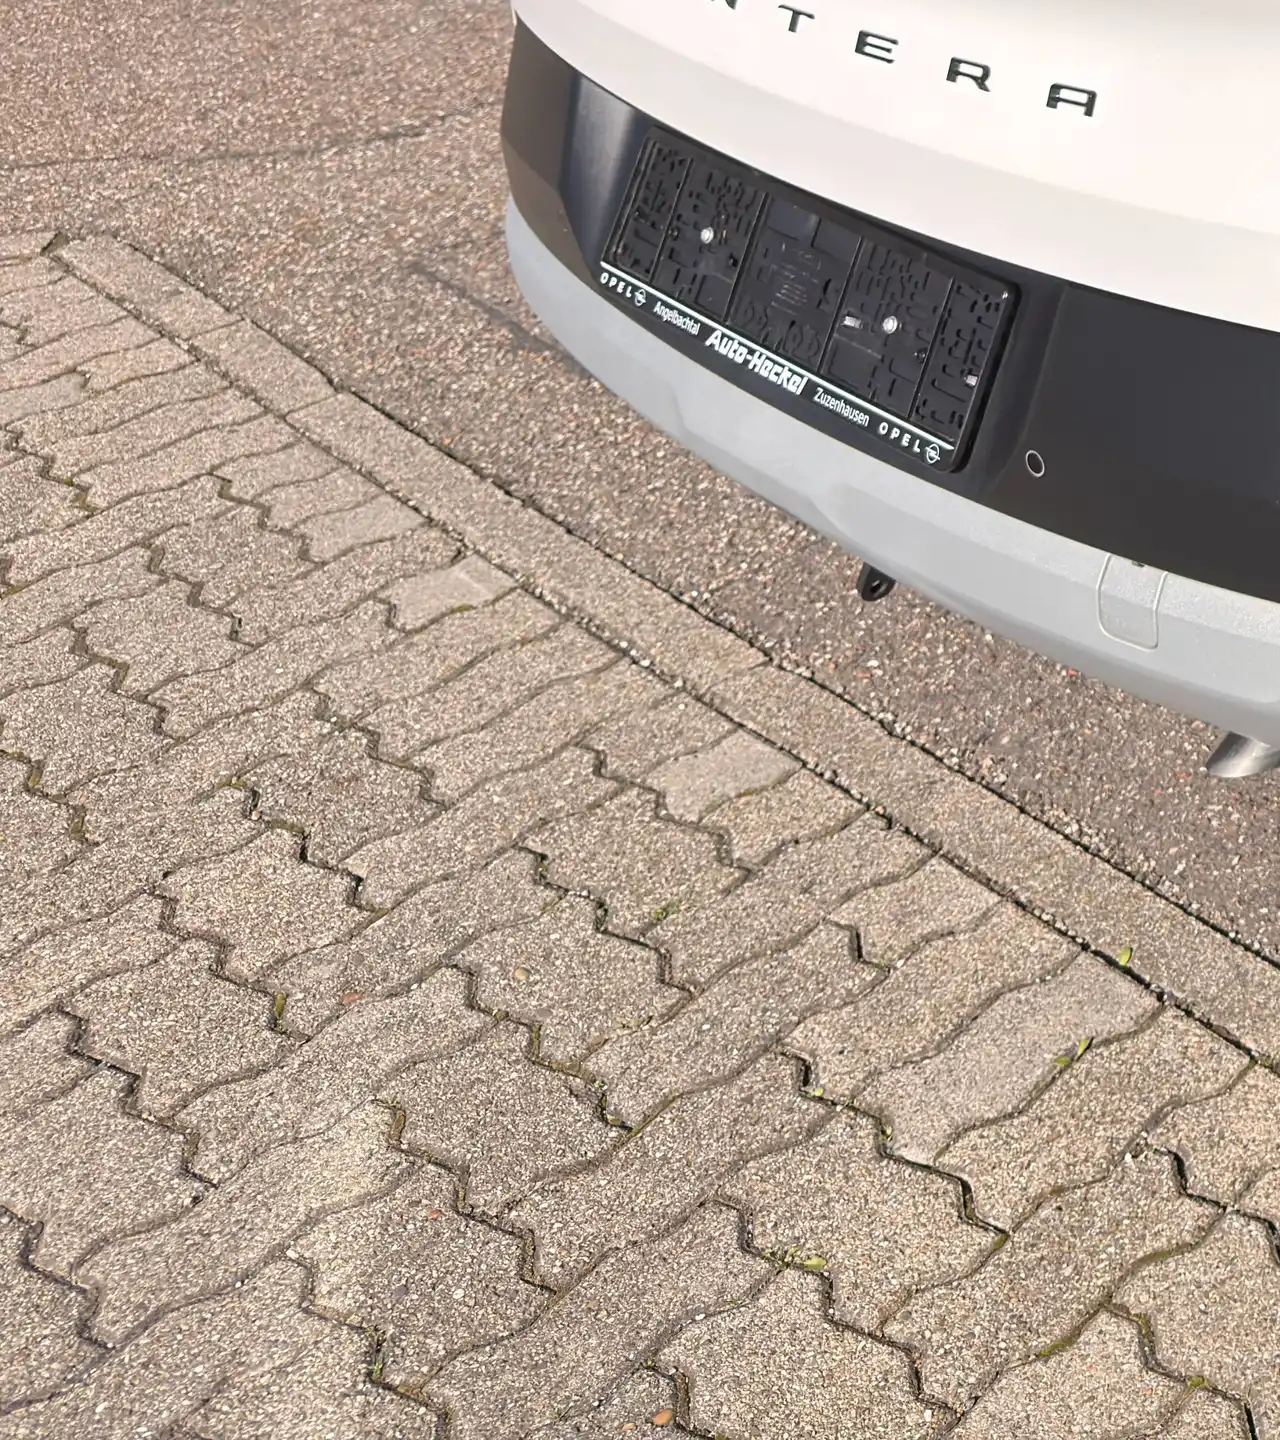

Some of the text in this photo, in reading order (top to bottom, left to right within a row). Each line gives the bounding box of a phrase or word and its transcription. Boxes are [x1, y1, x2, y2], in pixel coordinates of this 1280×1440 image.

[600, 272, 921, 453] OPEL Angelbachtal Auto-Heckel Zuzenhausen OPEL
